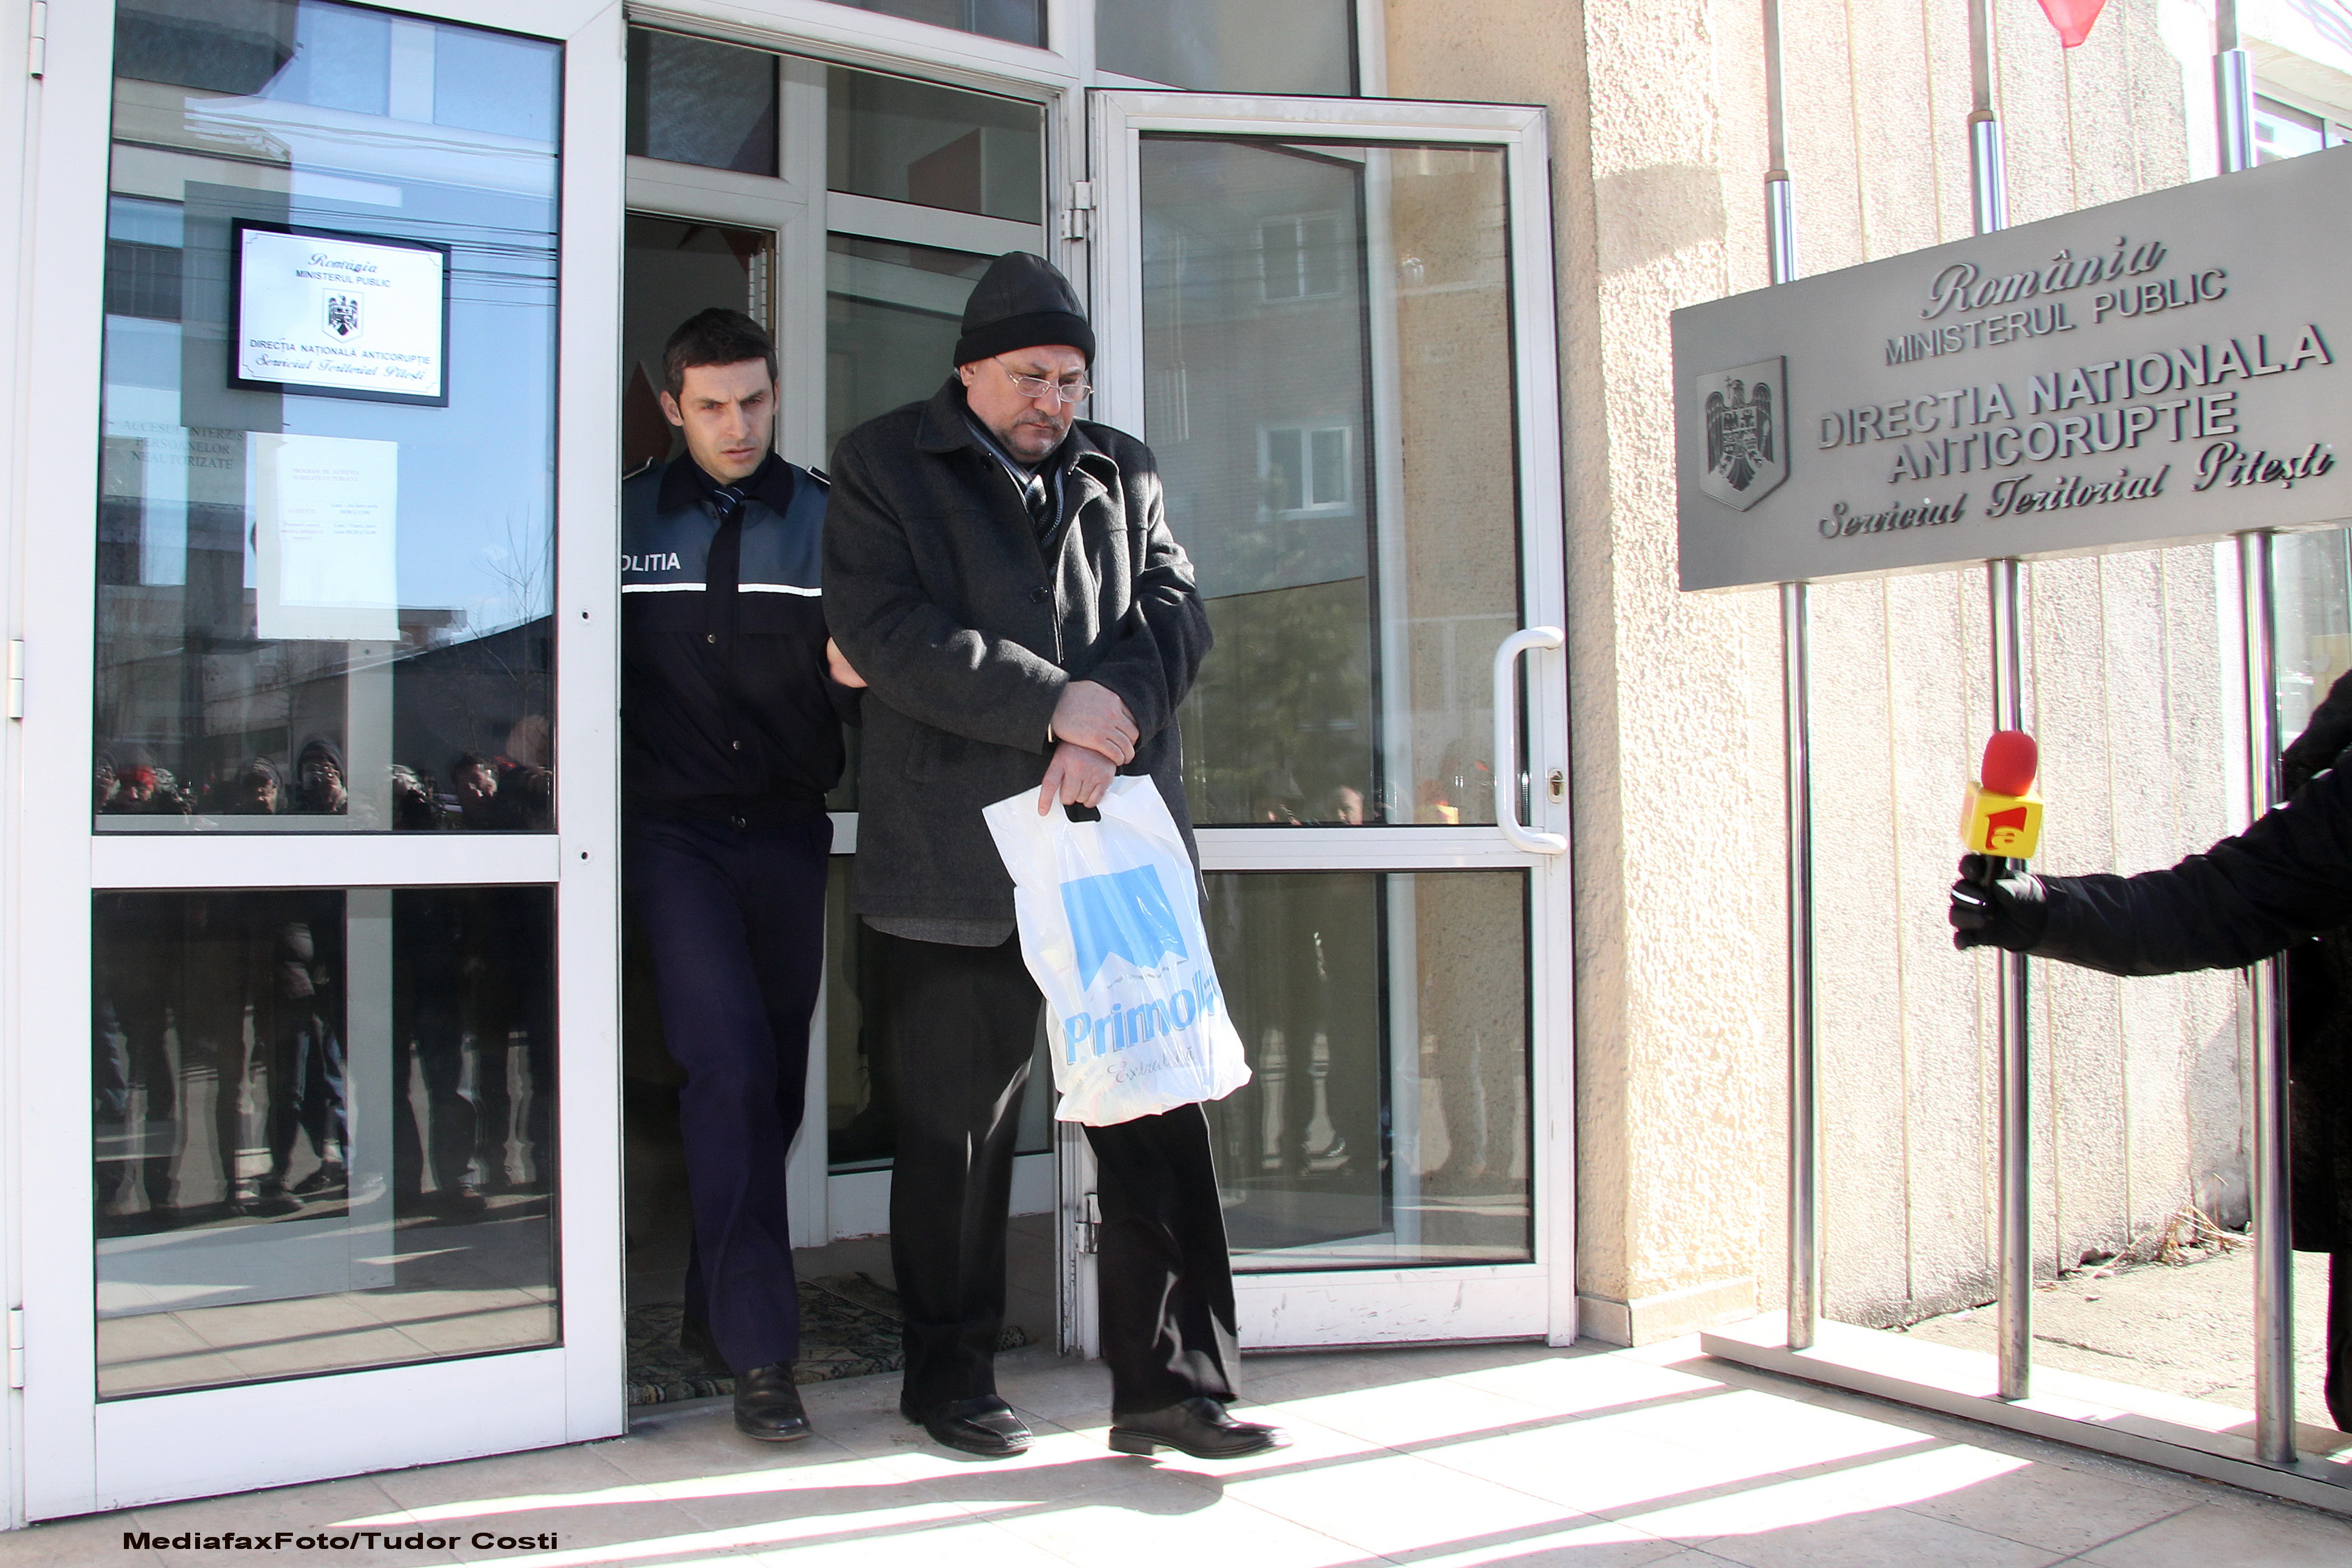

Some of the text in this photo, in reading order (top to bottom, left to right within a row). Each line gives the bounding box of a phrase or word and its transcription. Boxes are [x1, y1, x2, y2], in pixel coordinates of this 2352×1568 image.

[295, 270, 391, 288] MINISTERUL PUBLIC
[1884, 268, 2226, 366] MINISTERUL PUBLIC
[1919, 236, 2167, 320] România
[255, 353, 314, 370] Serviciul
[317, 359, 379, 375] Teritorial
[1818, 324, 2332, 450] DIRECTIA NATIONALA
[1887, 391, 2238, 483] ANTICORUPTIE
[1818, 492, 1969, 539] Serviciul
[1985, 464, 2171, 518] Teritorial
[622, 552, 682, 572] OLITIA
